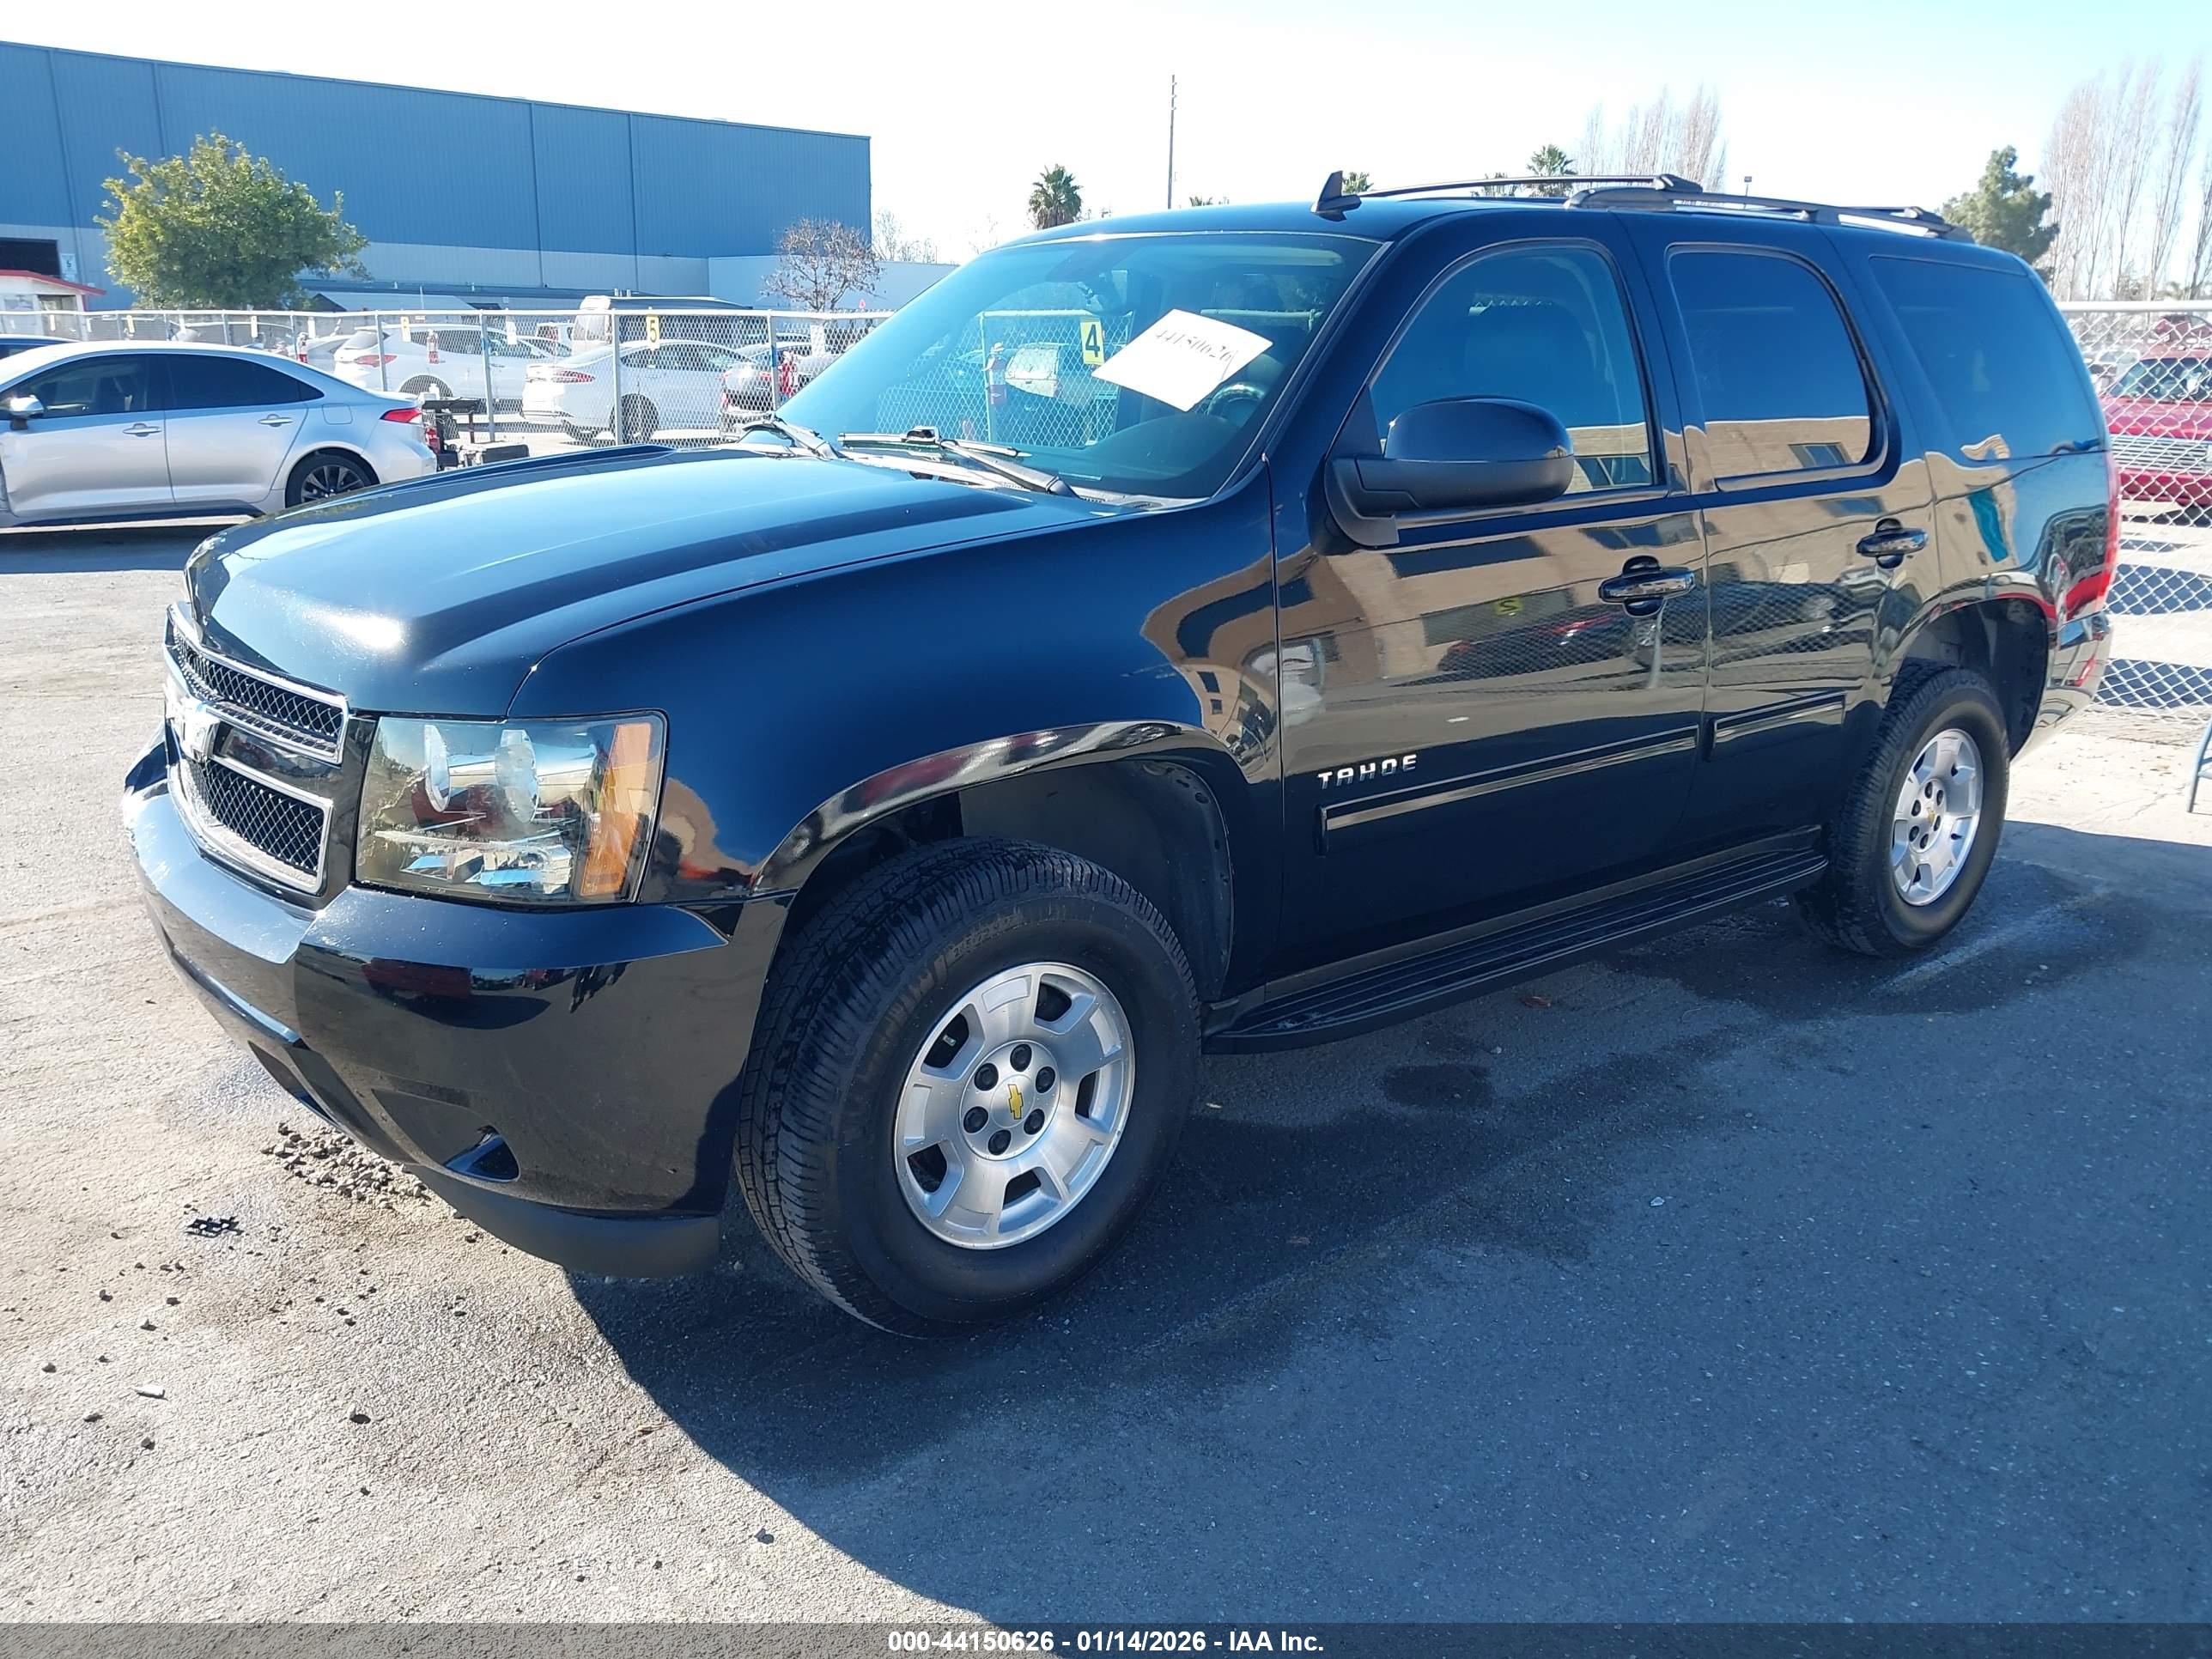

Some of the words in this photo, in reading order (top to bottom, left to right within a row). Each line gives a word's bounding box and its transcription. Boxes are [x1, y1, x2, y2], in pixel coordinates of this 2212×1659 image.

[650, 319, 657, 343] 5
[1085, 324, 1101, 358] 4
[1317, 754, 1417, 789] TAHOE
